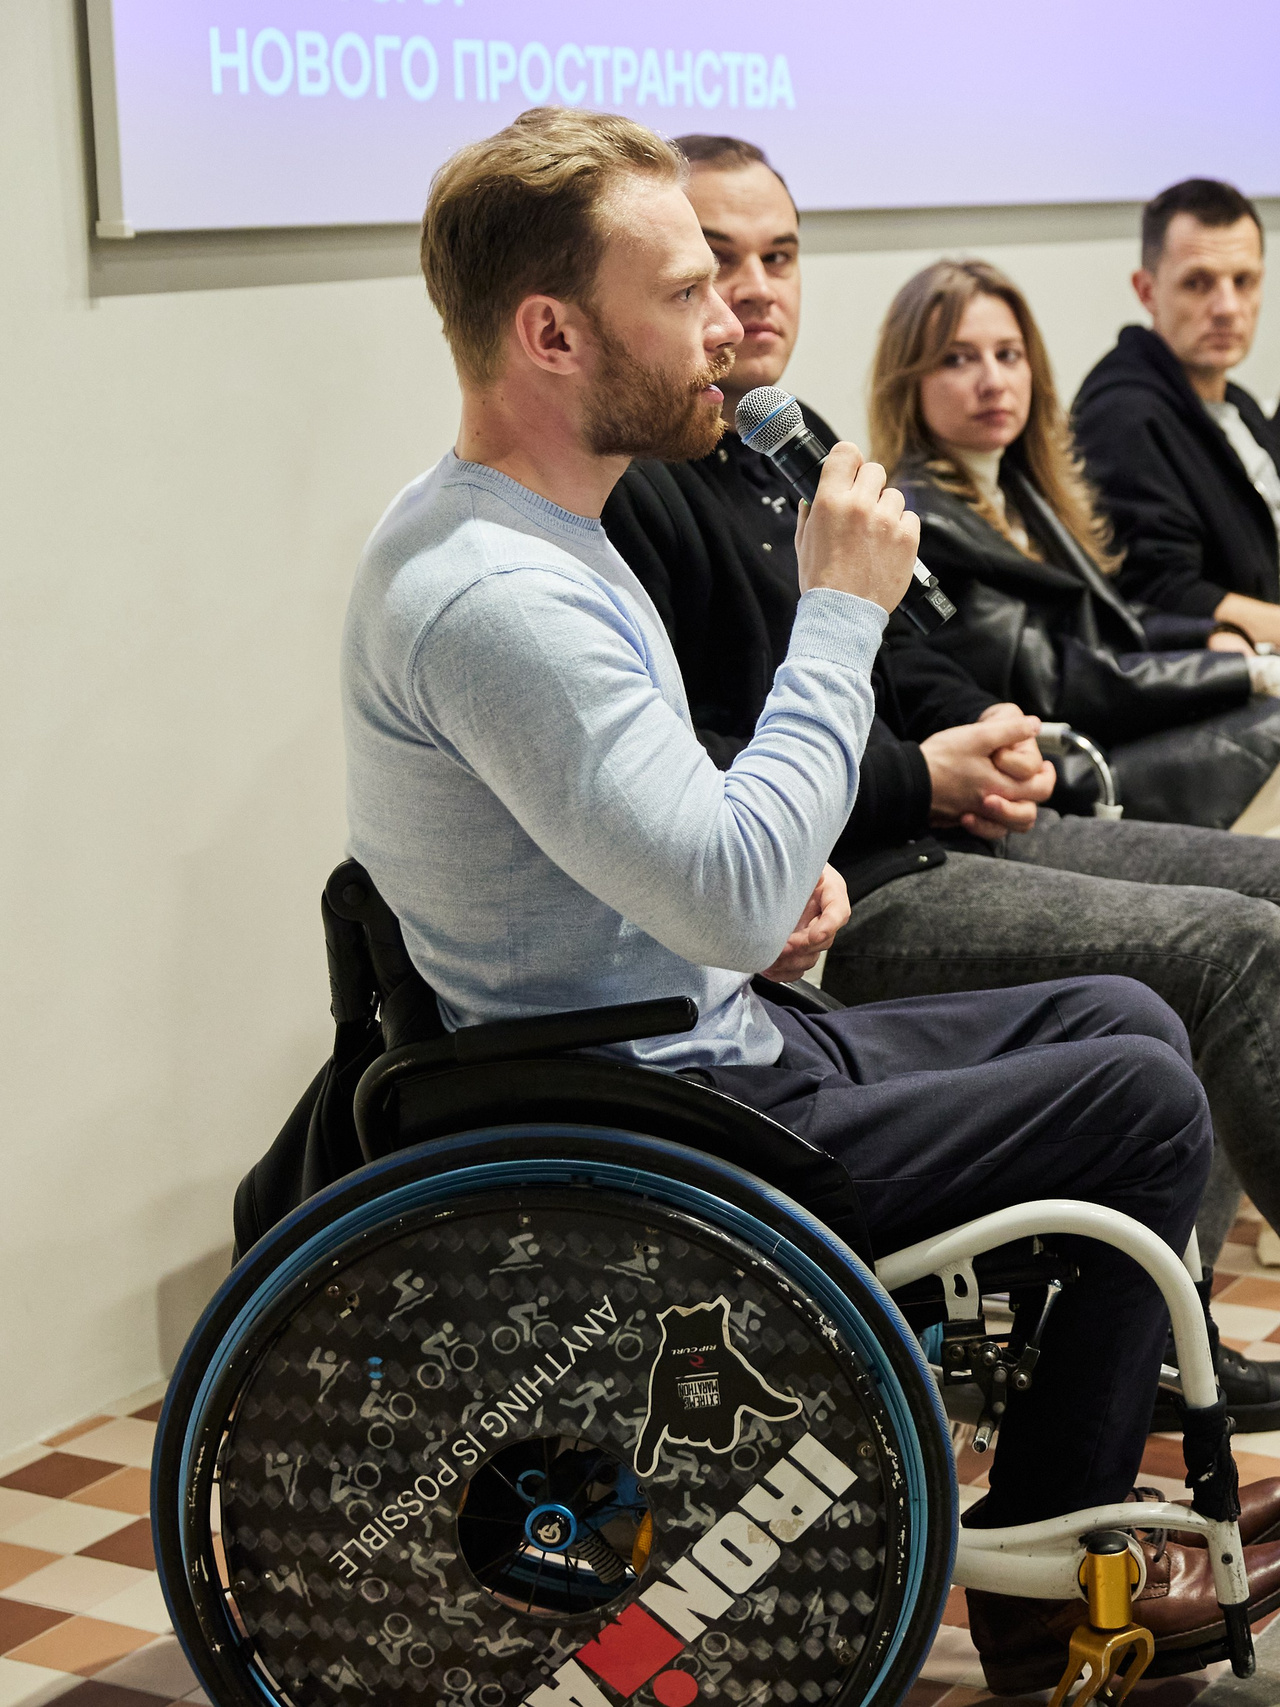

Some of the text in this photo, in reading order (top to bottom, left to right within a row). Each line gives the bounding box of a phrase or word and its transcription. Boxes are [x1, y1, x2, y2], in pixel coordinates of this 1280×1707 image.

[209, 26, 796, 110] НОВОГО ПРОСТРАНСТВА
[670, 1344, 717, 1356] RIP CURL
[678, 1380, 719, 1397] MARATHON
[683, 1393, 720, 1410] EXTREME
[328, 1294, 618, 1579] ANYTHING IS POSSIBLE
